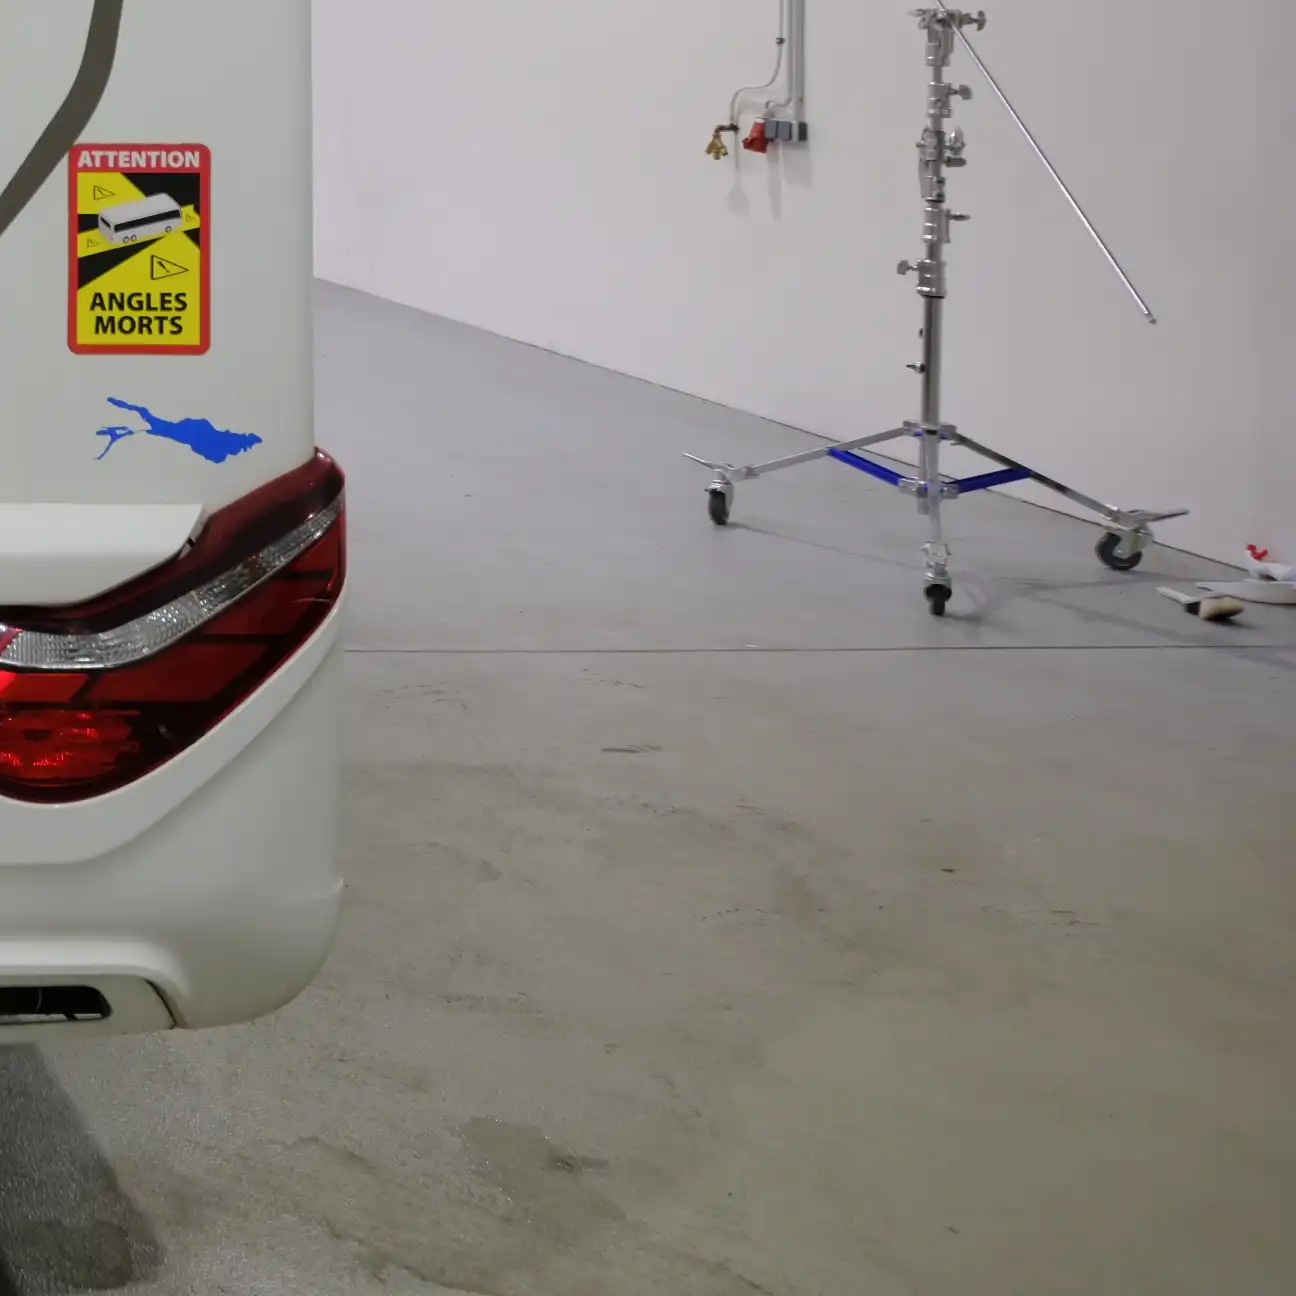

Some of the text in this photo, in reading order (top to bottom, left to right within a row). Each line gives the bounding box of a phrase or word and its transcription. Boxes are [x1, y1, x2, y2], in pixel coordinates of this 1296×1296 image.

[78, 151, 200, 168] ATTENTION
[90, 292, 187, 311] ANGLES
[95, 316, 183, 335] MORTS
